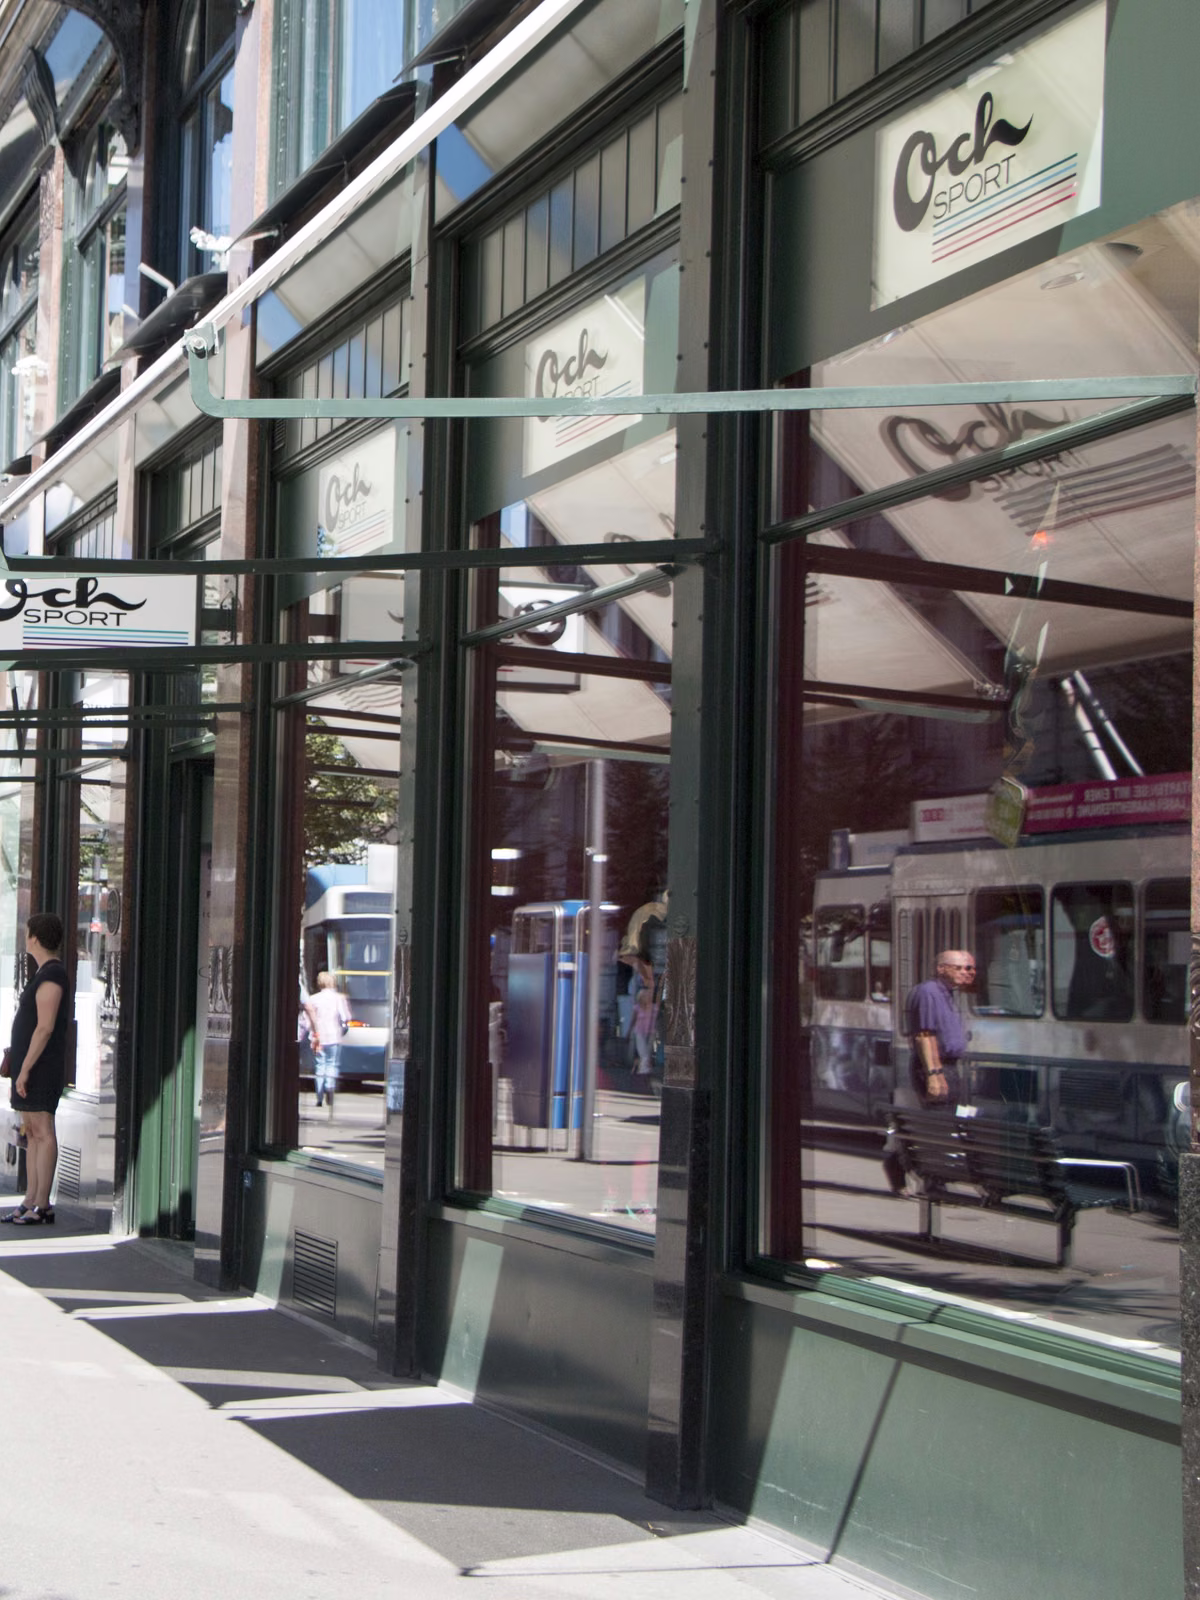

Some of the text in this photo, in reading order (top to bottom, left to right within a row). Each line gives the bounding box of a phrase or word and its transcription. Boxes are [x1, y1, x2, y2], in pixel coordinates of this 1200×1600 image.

[893, 91, 1035, 232] Och
[932, 153, 1017, 220] SPORT
[535, 328, 608, 422] Och
[325, 462, 372, 533] Och
[23, 608, 127, 627] SPORT
